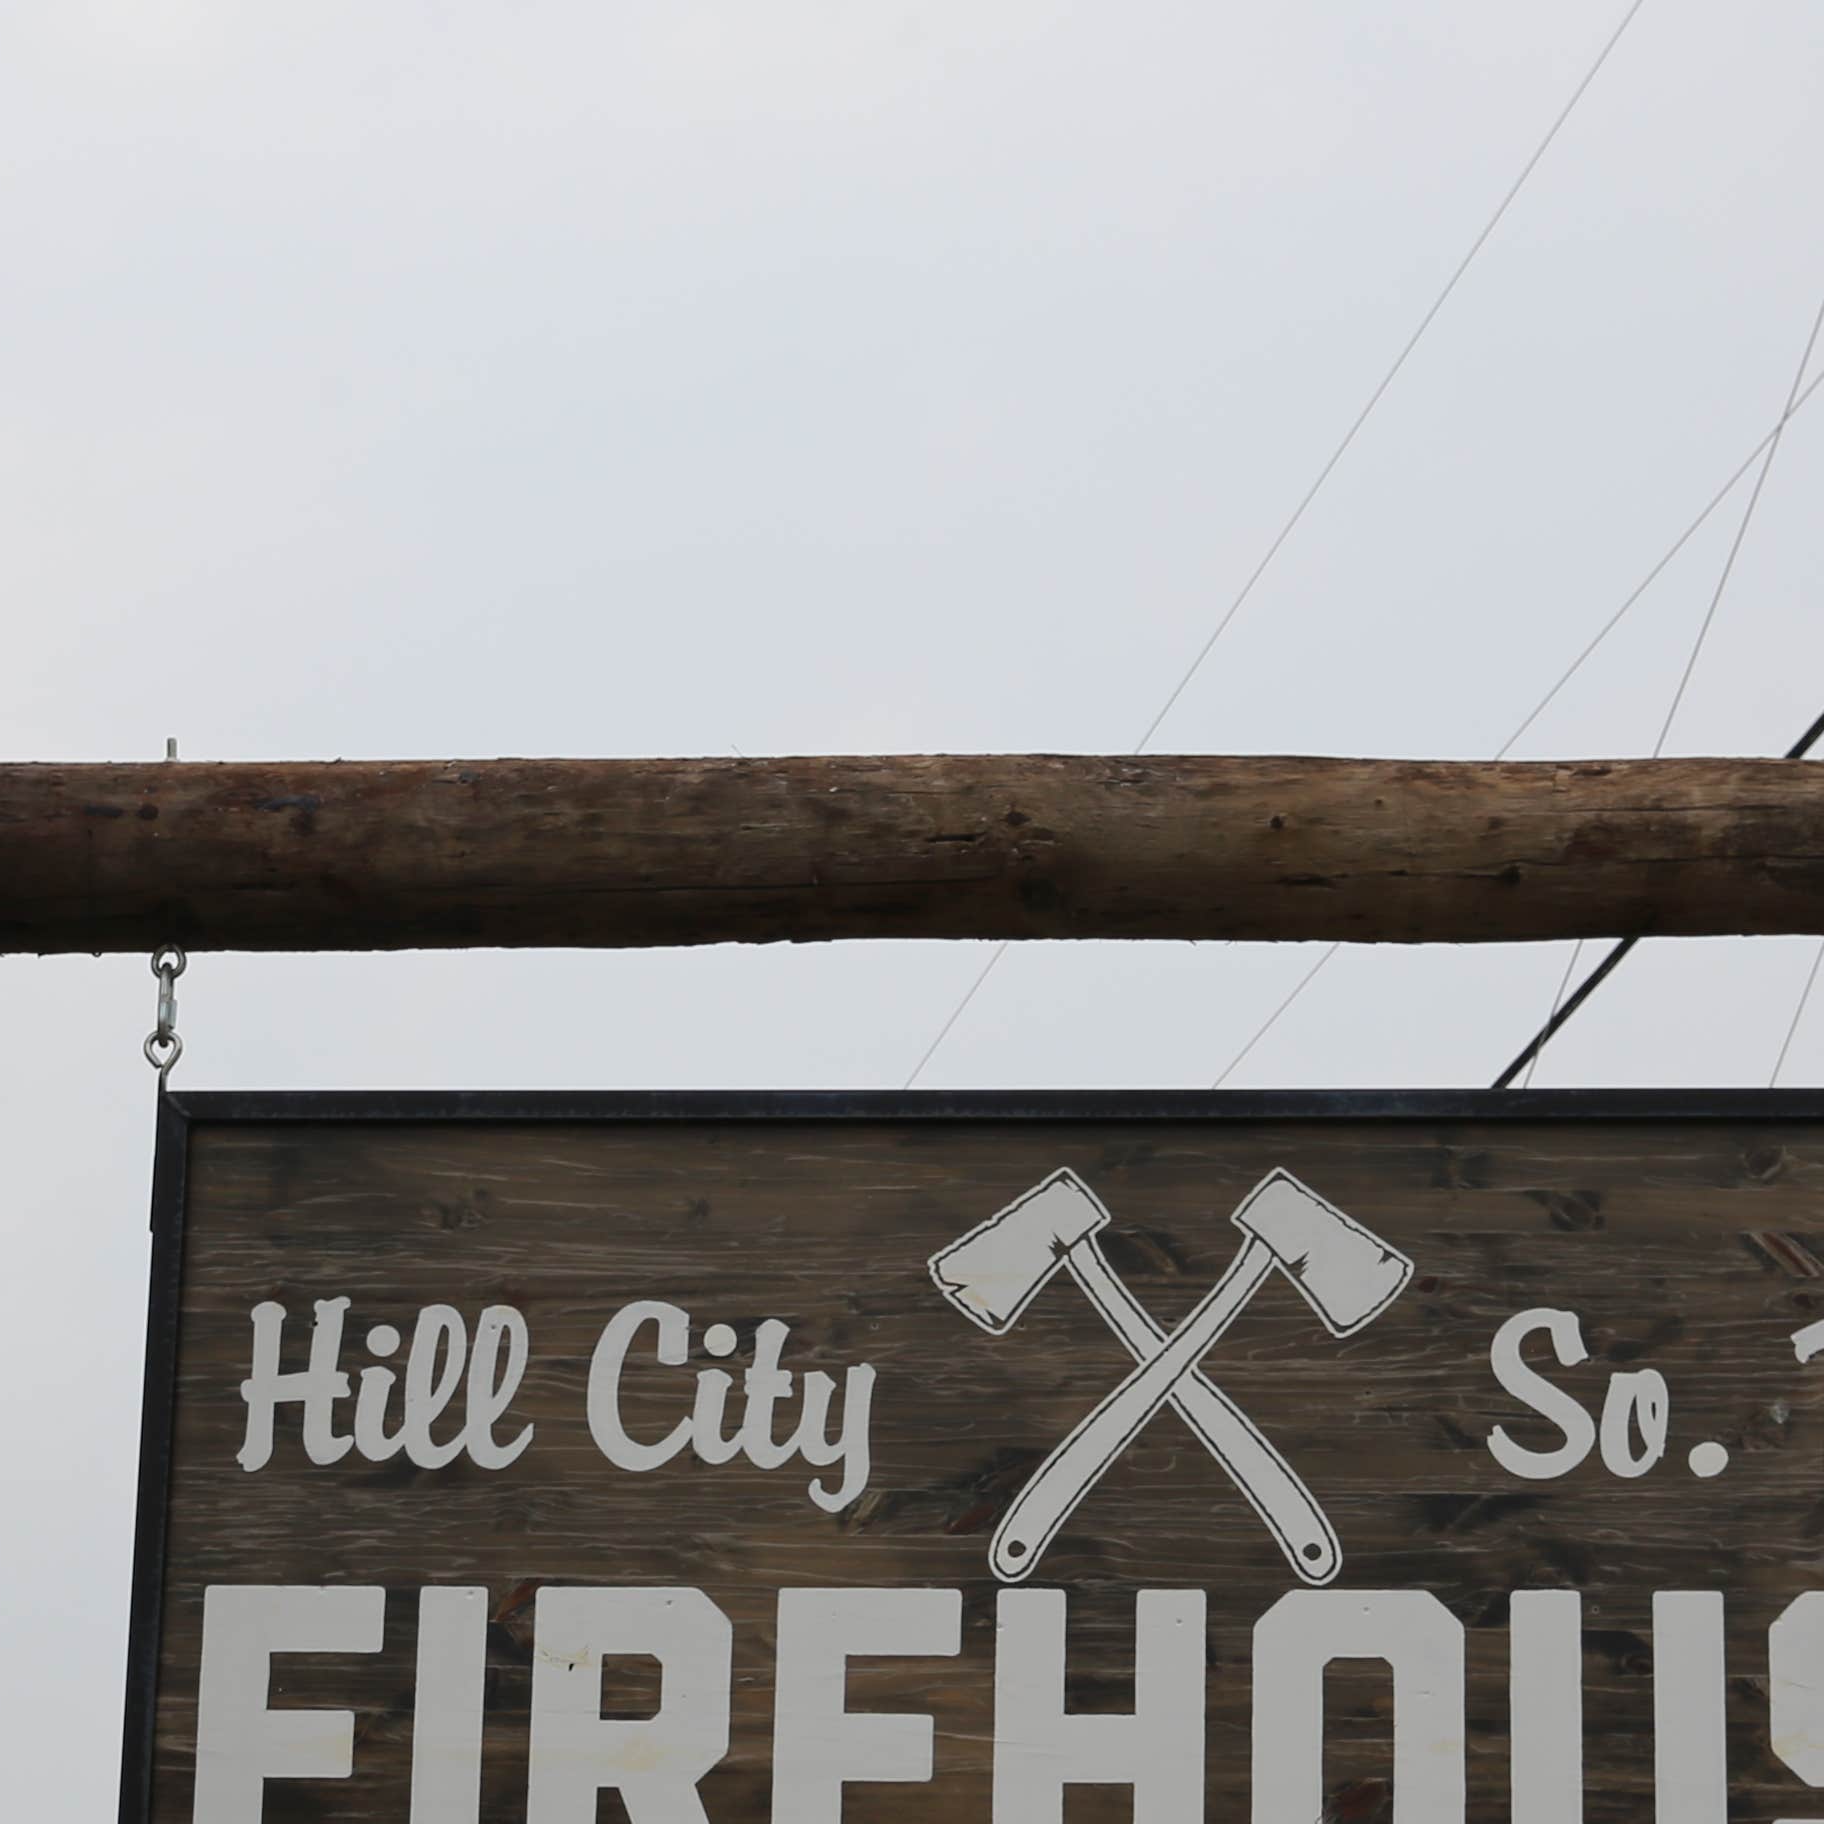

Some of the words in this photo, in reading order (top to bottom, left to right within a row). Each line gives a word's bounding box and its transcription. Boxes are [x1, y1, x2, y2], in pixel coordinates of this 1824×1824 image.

[236, 1296, 534, 1472] Hill
[586, 1299, 876, 1513] City
[1486, 1307, 1730, 1480] So.
